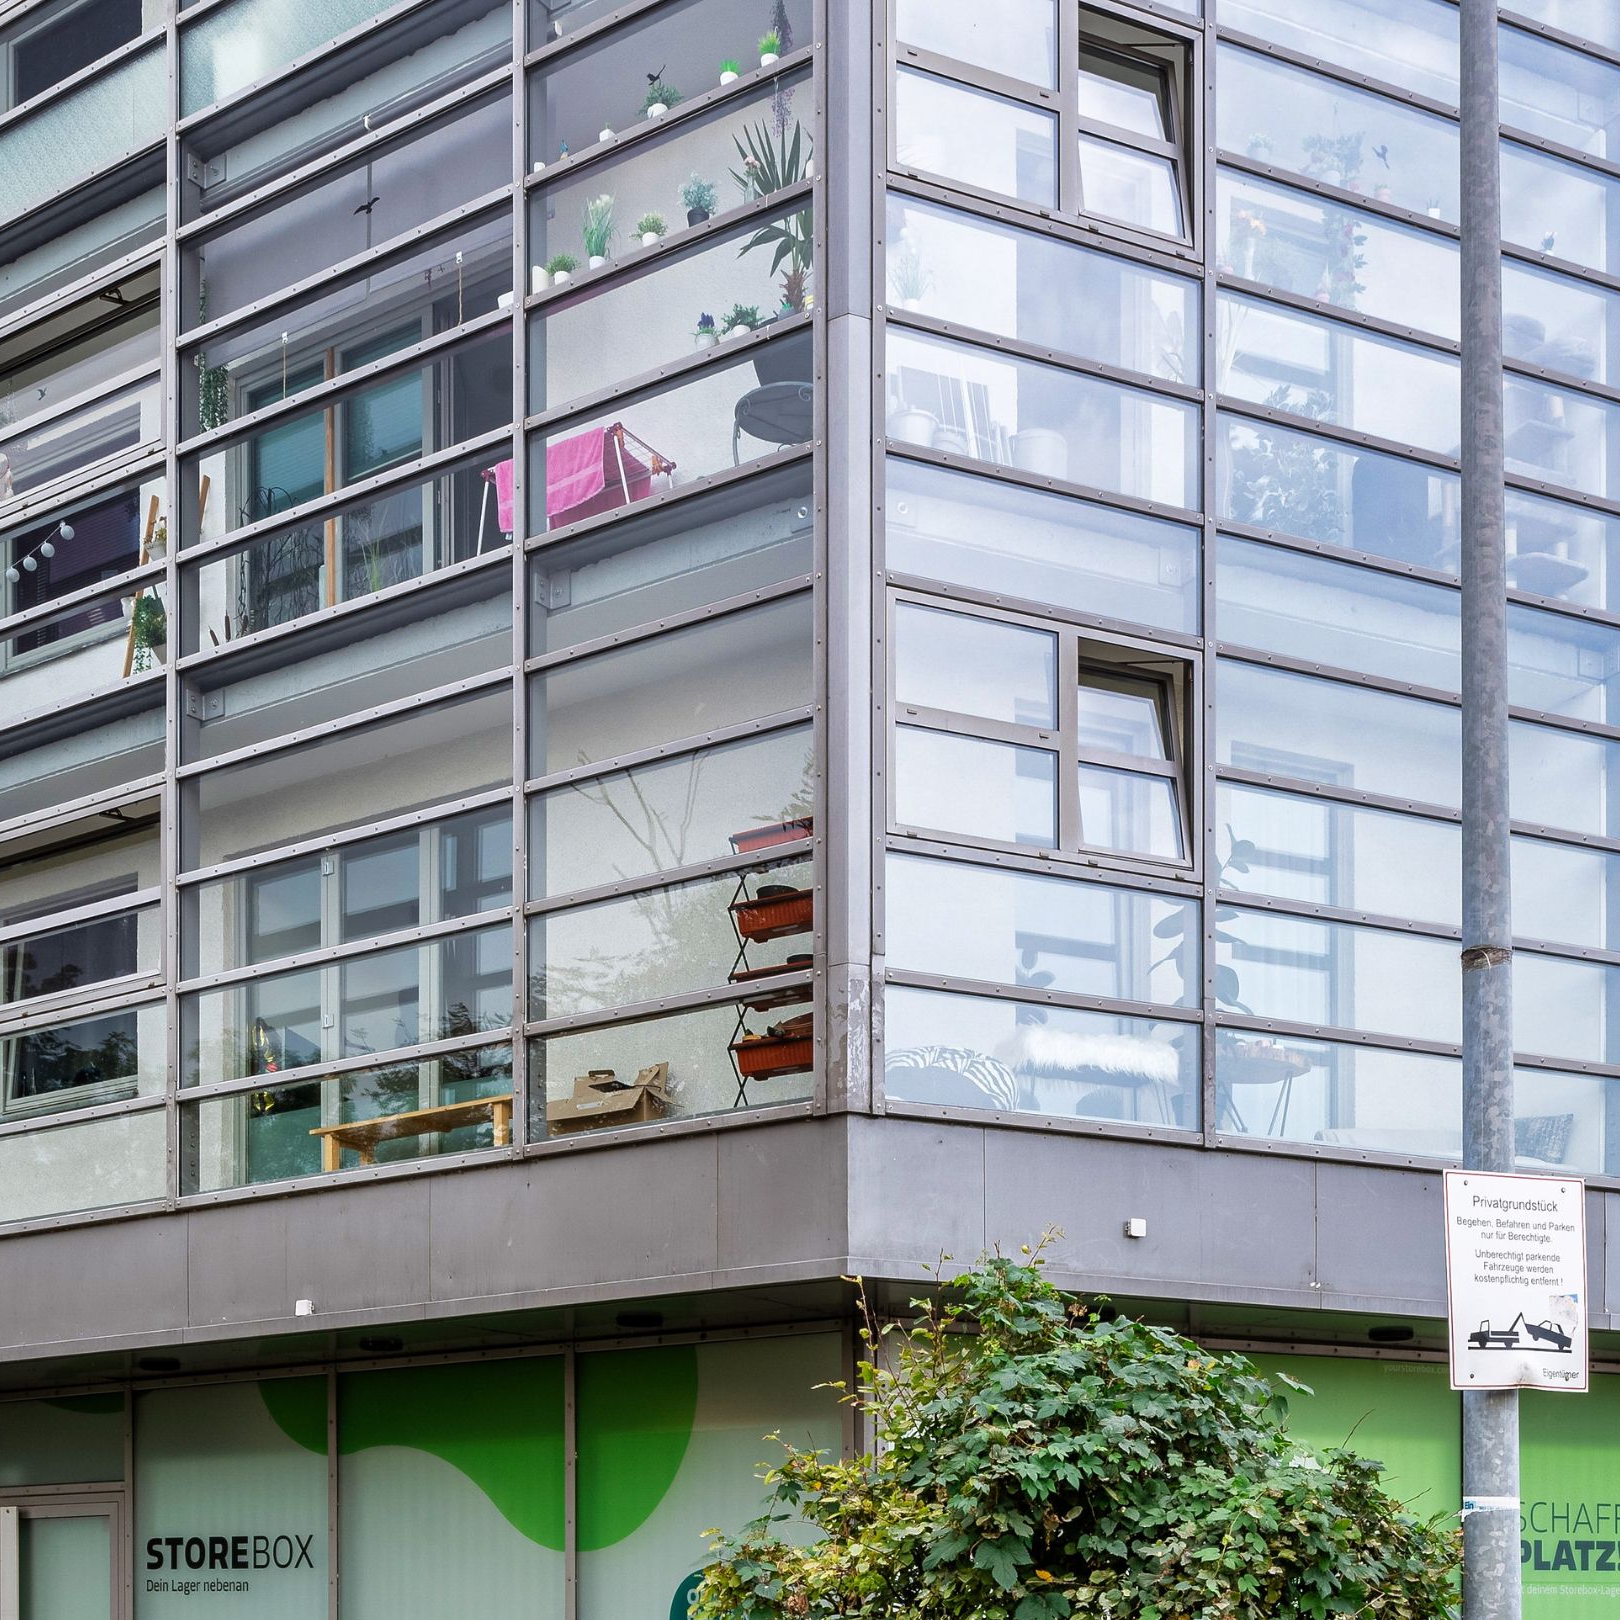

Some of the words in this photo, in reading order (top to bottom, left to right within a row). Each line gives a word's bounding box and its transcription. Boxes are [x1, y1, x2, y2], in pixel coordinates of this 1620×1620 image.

[1472, 1195, 1558, 1213] Privatgrundstück
[1456, 1216, 1494, 1229] Begehen,
[1495, 1218, 1530, 1230] Befahren
[1532, 1222, 1547, 1231] und
[1548, 1221, 1575, 1232] Parken
[1480, 1231, 1494, 1240] nur
[1495, 1231, 1506, 1240] für
[1474, 1249, 1524, 1263] Unberechtigt
[1525, 1252, 1561, 1264] parkende
[1483, 1261, 1524, 1275] Fahrzeuge
[1526, 1264, 1554, 1274] werden
[1474, 1273, 1530, 1287] kostenpflichtig
[1530, 1276, 1559, 1286] entfernt
[1542, 1367, 1580, 1380] Eigentümer
[146, 1534, 314, 1570] STOREBOX
[146, 1579, 169, 1592] Dein
[171, 1579, 201, 1595] Lager
[203, 1578, 249, 1592] nebenan
[1527, 1583, 1559, 1595] deinem
